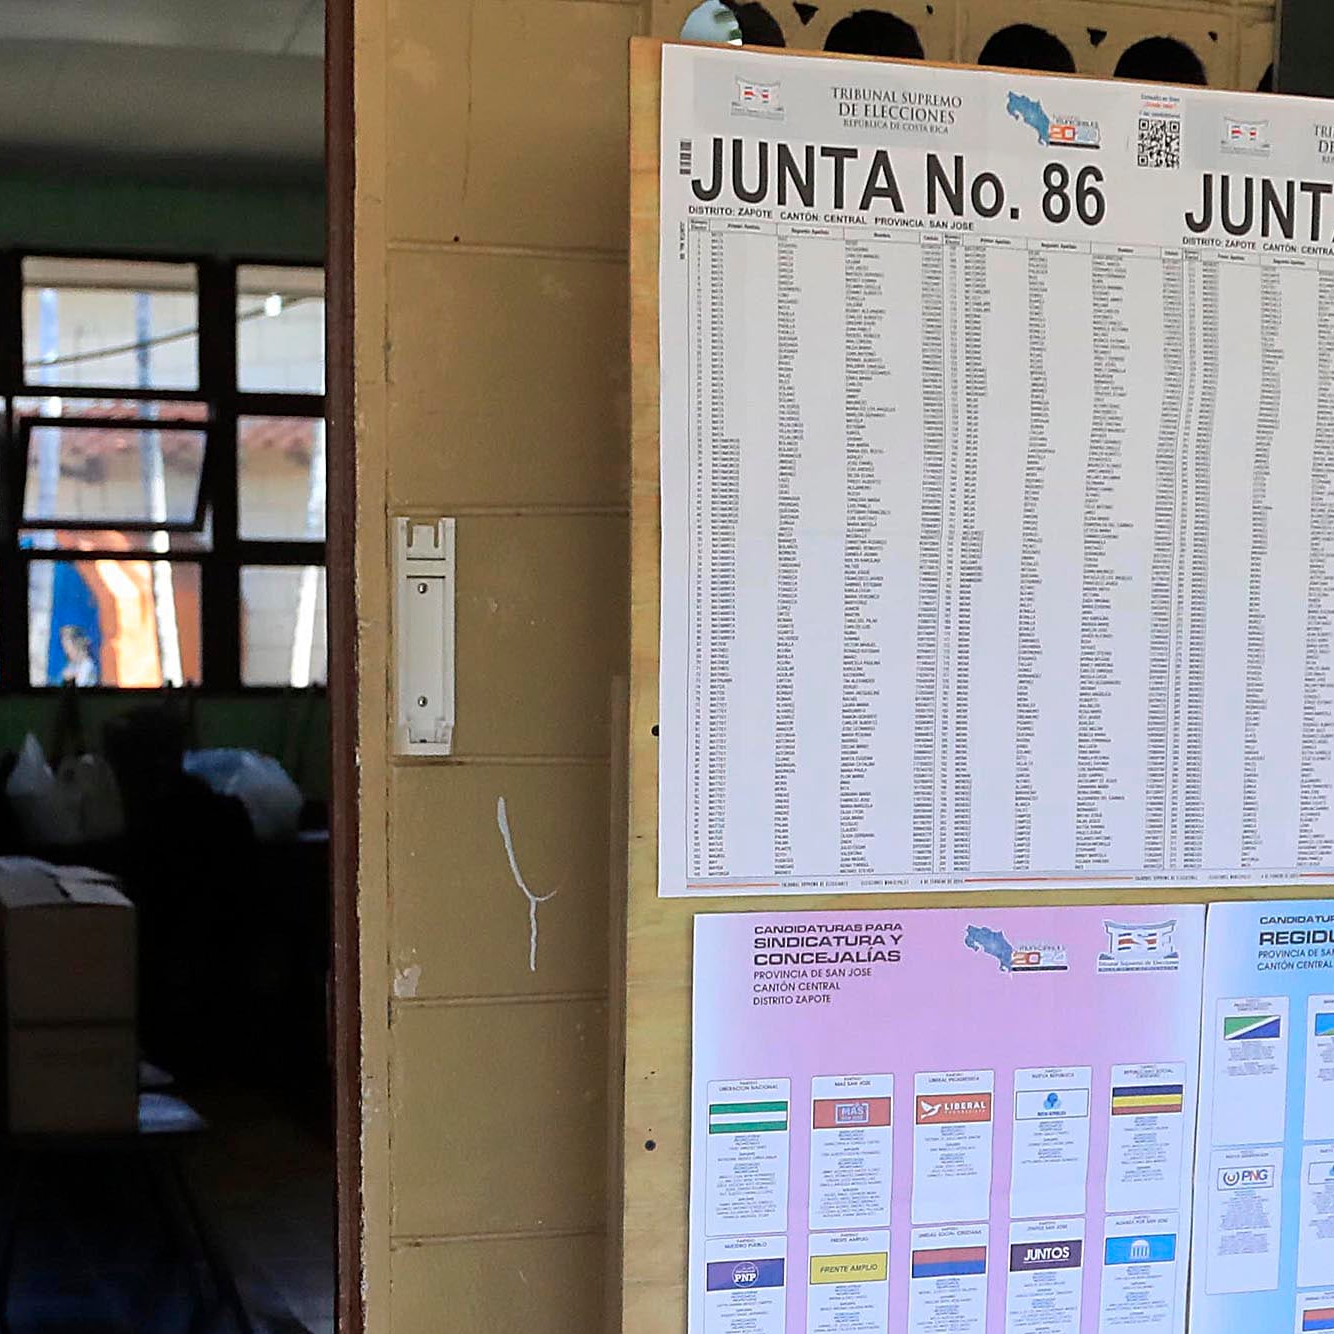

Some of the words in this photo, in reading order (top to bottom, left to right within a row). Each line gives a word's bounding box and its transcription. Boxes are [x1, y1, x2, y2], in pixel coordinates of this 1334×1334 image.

[831, 86, 897, 103] TRIBUNAL
[902, 91, 962, 109] SUPREMO
[839, 102, 859, 117] DE
[864, 103, 955, 125] ELECCIONES
[1318, 140, 1334, 153] DE
[691, 138, 905, 213] JUNTA
[927, 154, 1019, 219] No.
[1042, 162, 1106, 226] 86
[738, 208, 773, 219] ZAPOTE
[824, 214, 867, 225] CENTRAL
[929, 221, 948, 229] SAN
[1225, 239, 1256, 249] ZAPOTE
[754, 923, 862, 935] CANDIDATURAS
[865, 923, 903, 932] PARA
[754, 935, 885, 949] SINDICATURA
[890, 934, 903, 946] Y
[754, 946, 901, 966] CONCEJALÍAS
[1258, 949, 1305, 959] PROVINCIA
[1308, 948, 1319, 957] DE
[1257, 960, 1294, 971] CANTÓN
[1296, 960, 1333, 970] CENTRAL
[753, 969, 808, 980] PROVINCIA
[811, 969, 823, 978] DE
[826, 968, 846, 978] SAN
[848, 967, 872, 977] JOSE
[753, 981, 795, 993] CANTÓN
[798, 981, 841, 991] CENTRAL
[753, 995, 794, 1006] DISTRITO
[796, 994, 831, 1004] ZAPOTE
[944, 1101, 986, 1110] LIBERAL
[1241, 1169, 1268, 1182] PNG
[1024, 1246, 1070, 1261] JUNTOS
[820, 1265, 849, 1273] FRENTE
[850, 1264, 878, 1272] AMPLIO
[734, 1273, 757, 1283] PNP
